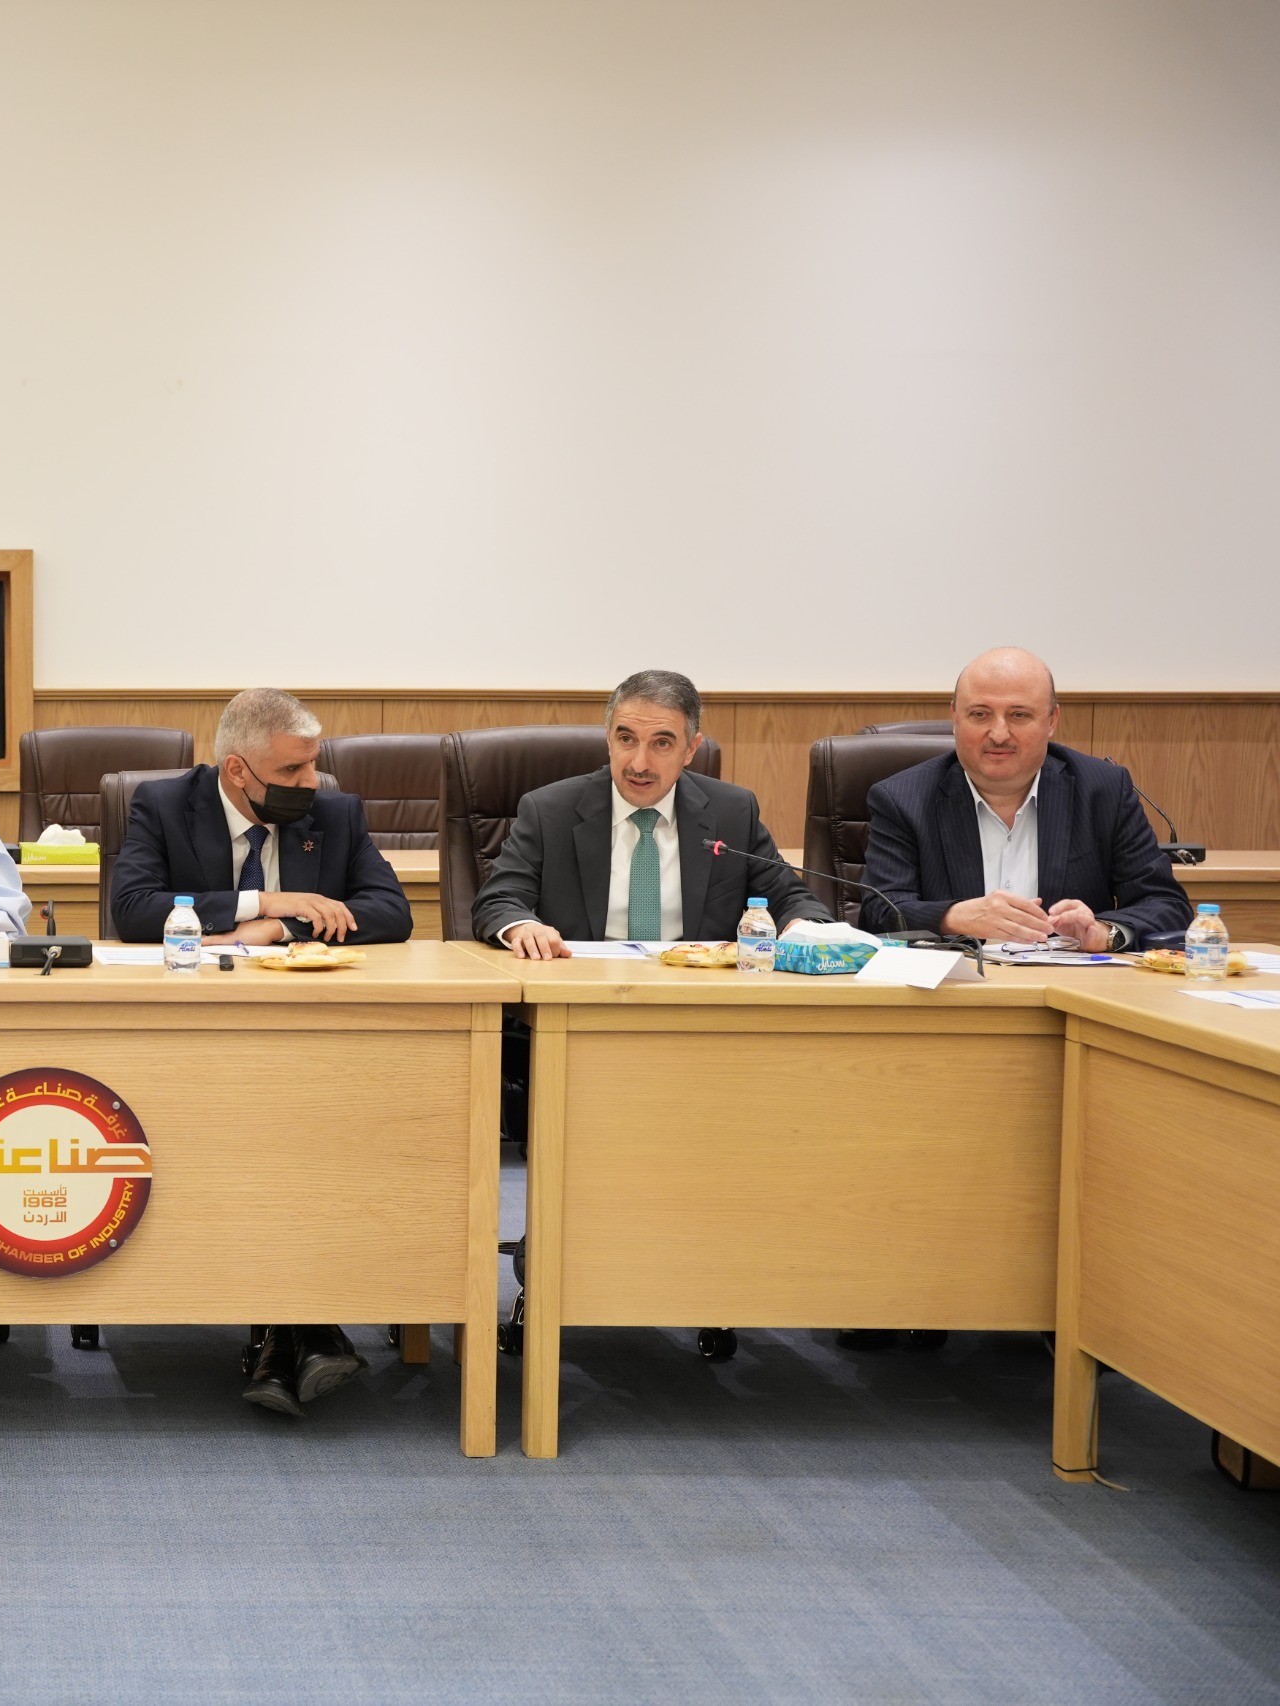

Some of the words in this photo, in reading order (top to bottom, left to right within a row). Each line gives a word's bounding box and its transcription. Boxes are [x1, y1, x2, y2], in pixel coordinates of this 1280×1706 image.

[6, 1082, 82, 1103] صناعة
[83, 1094, 127, 1139] غرفة
[23, 1196, 67, 1207] 1962
[68, 1244, 88, 1260] OF
[90, 1180, 134, 1249] INDUSTRY
